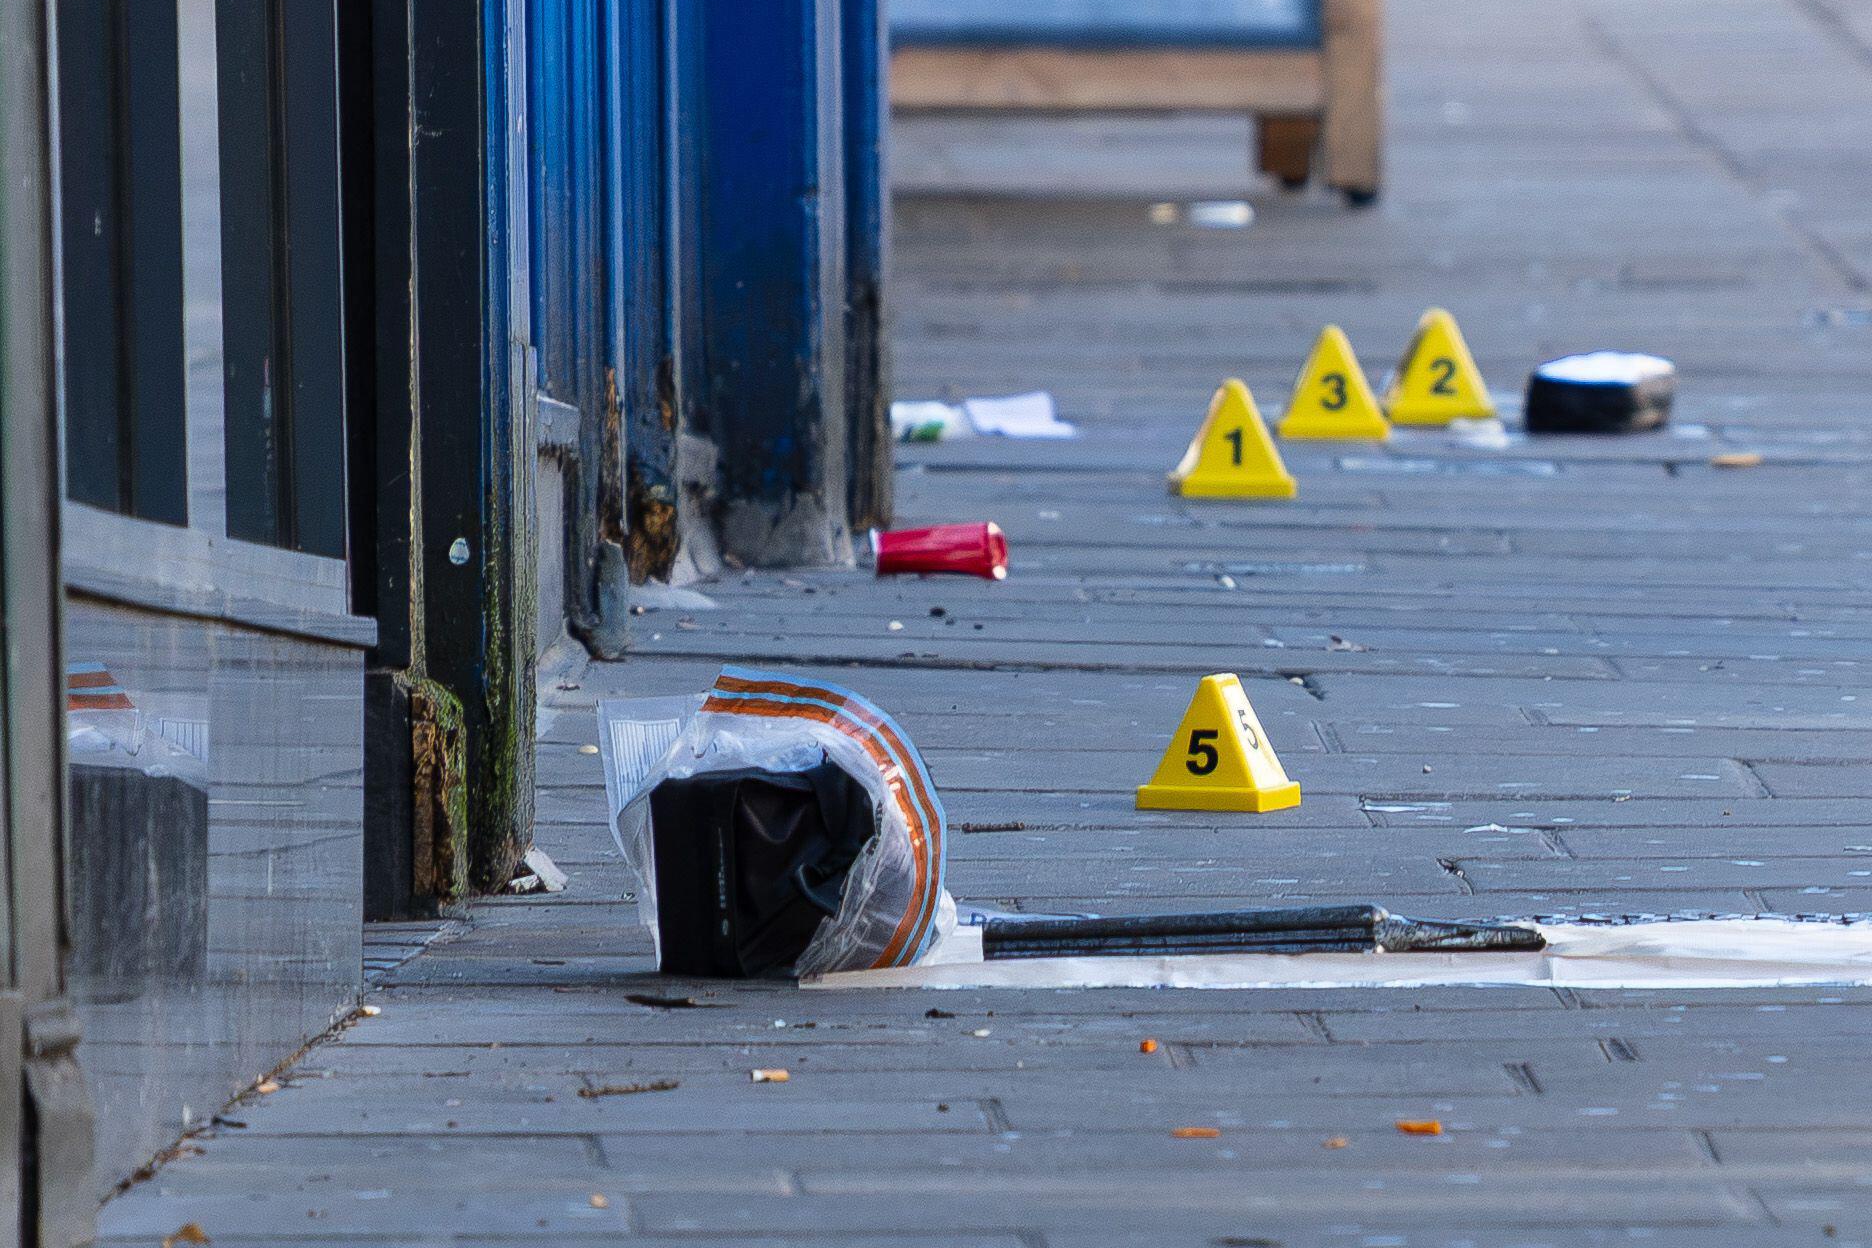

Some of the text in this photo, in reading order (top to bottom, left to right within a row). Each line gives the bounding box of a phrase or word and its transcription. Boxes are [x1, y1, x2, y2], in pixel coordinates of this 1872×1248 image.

[1320, 373, 1348, 411] 3
[1429, 359, 1456, 396] 2
[1224, 428, 1243, 466] 1
[1186, 729, 1219, 776] 5
